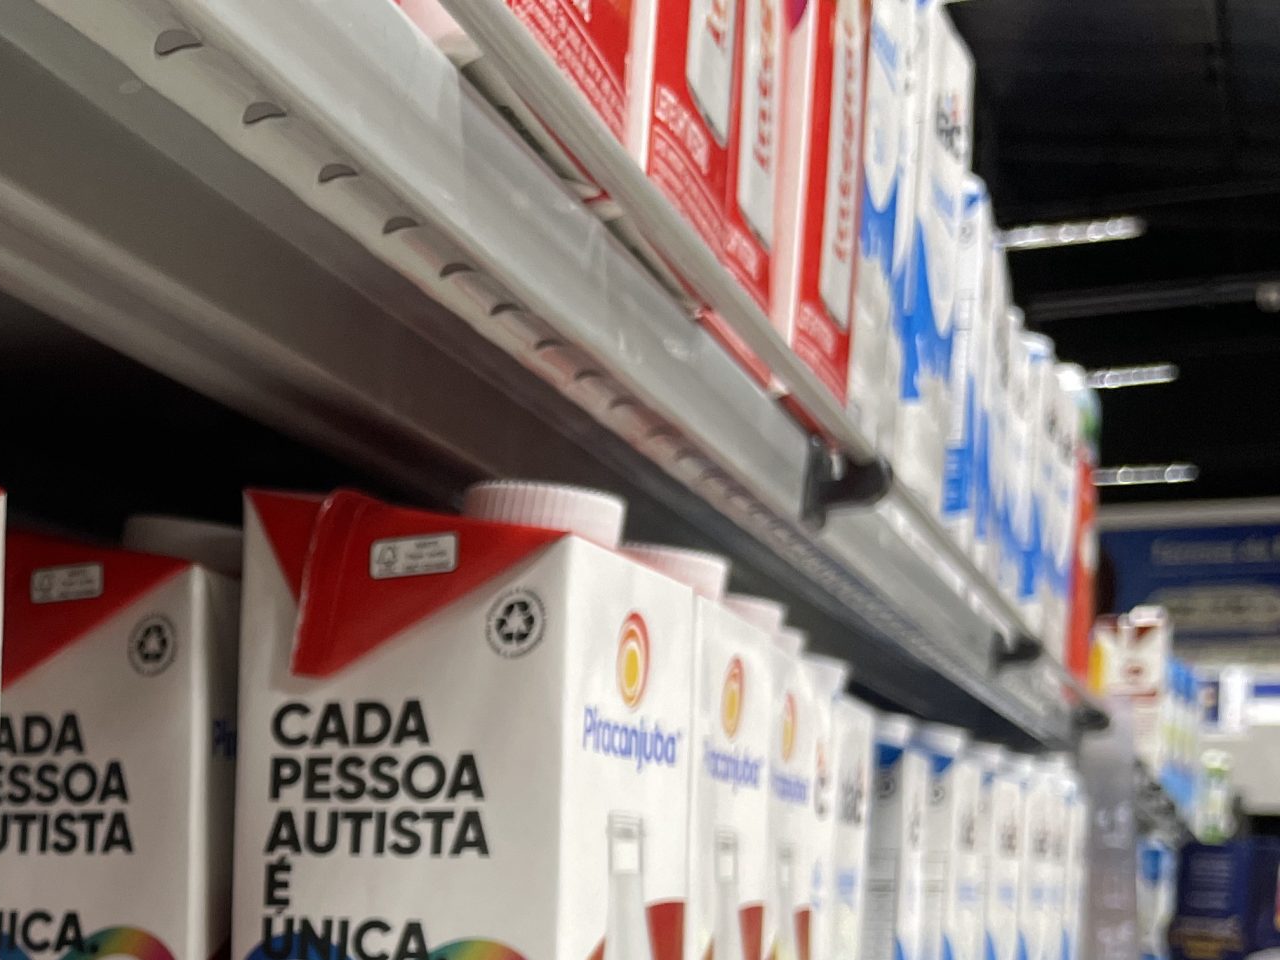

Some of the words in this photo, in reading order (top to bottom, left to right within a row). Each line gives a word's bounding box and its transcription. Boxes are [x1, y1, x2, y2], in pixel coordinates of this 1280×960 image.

[0, 711, 84, 755] ADA
[272, 700, 430, 747] CADA
[582, 705, 677, 773] Piracanjuba
[269, 753, 485, 801] PESSOA
[264, 809, 491, 858] AUTISTA
[264, 856, 293, 907] É
